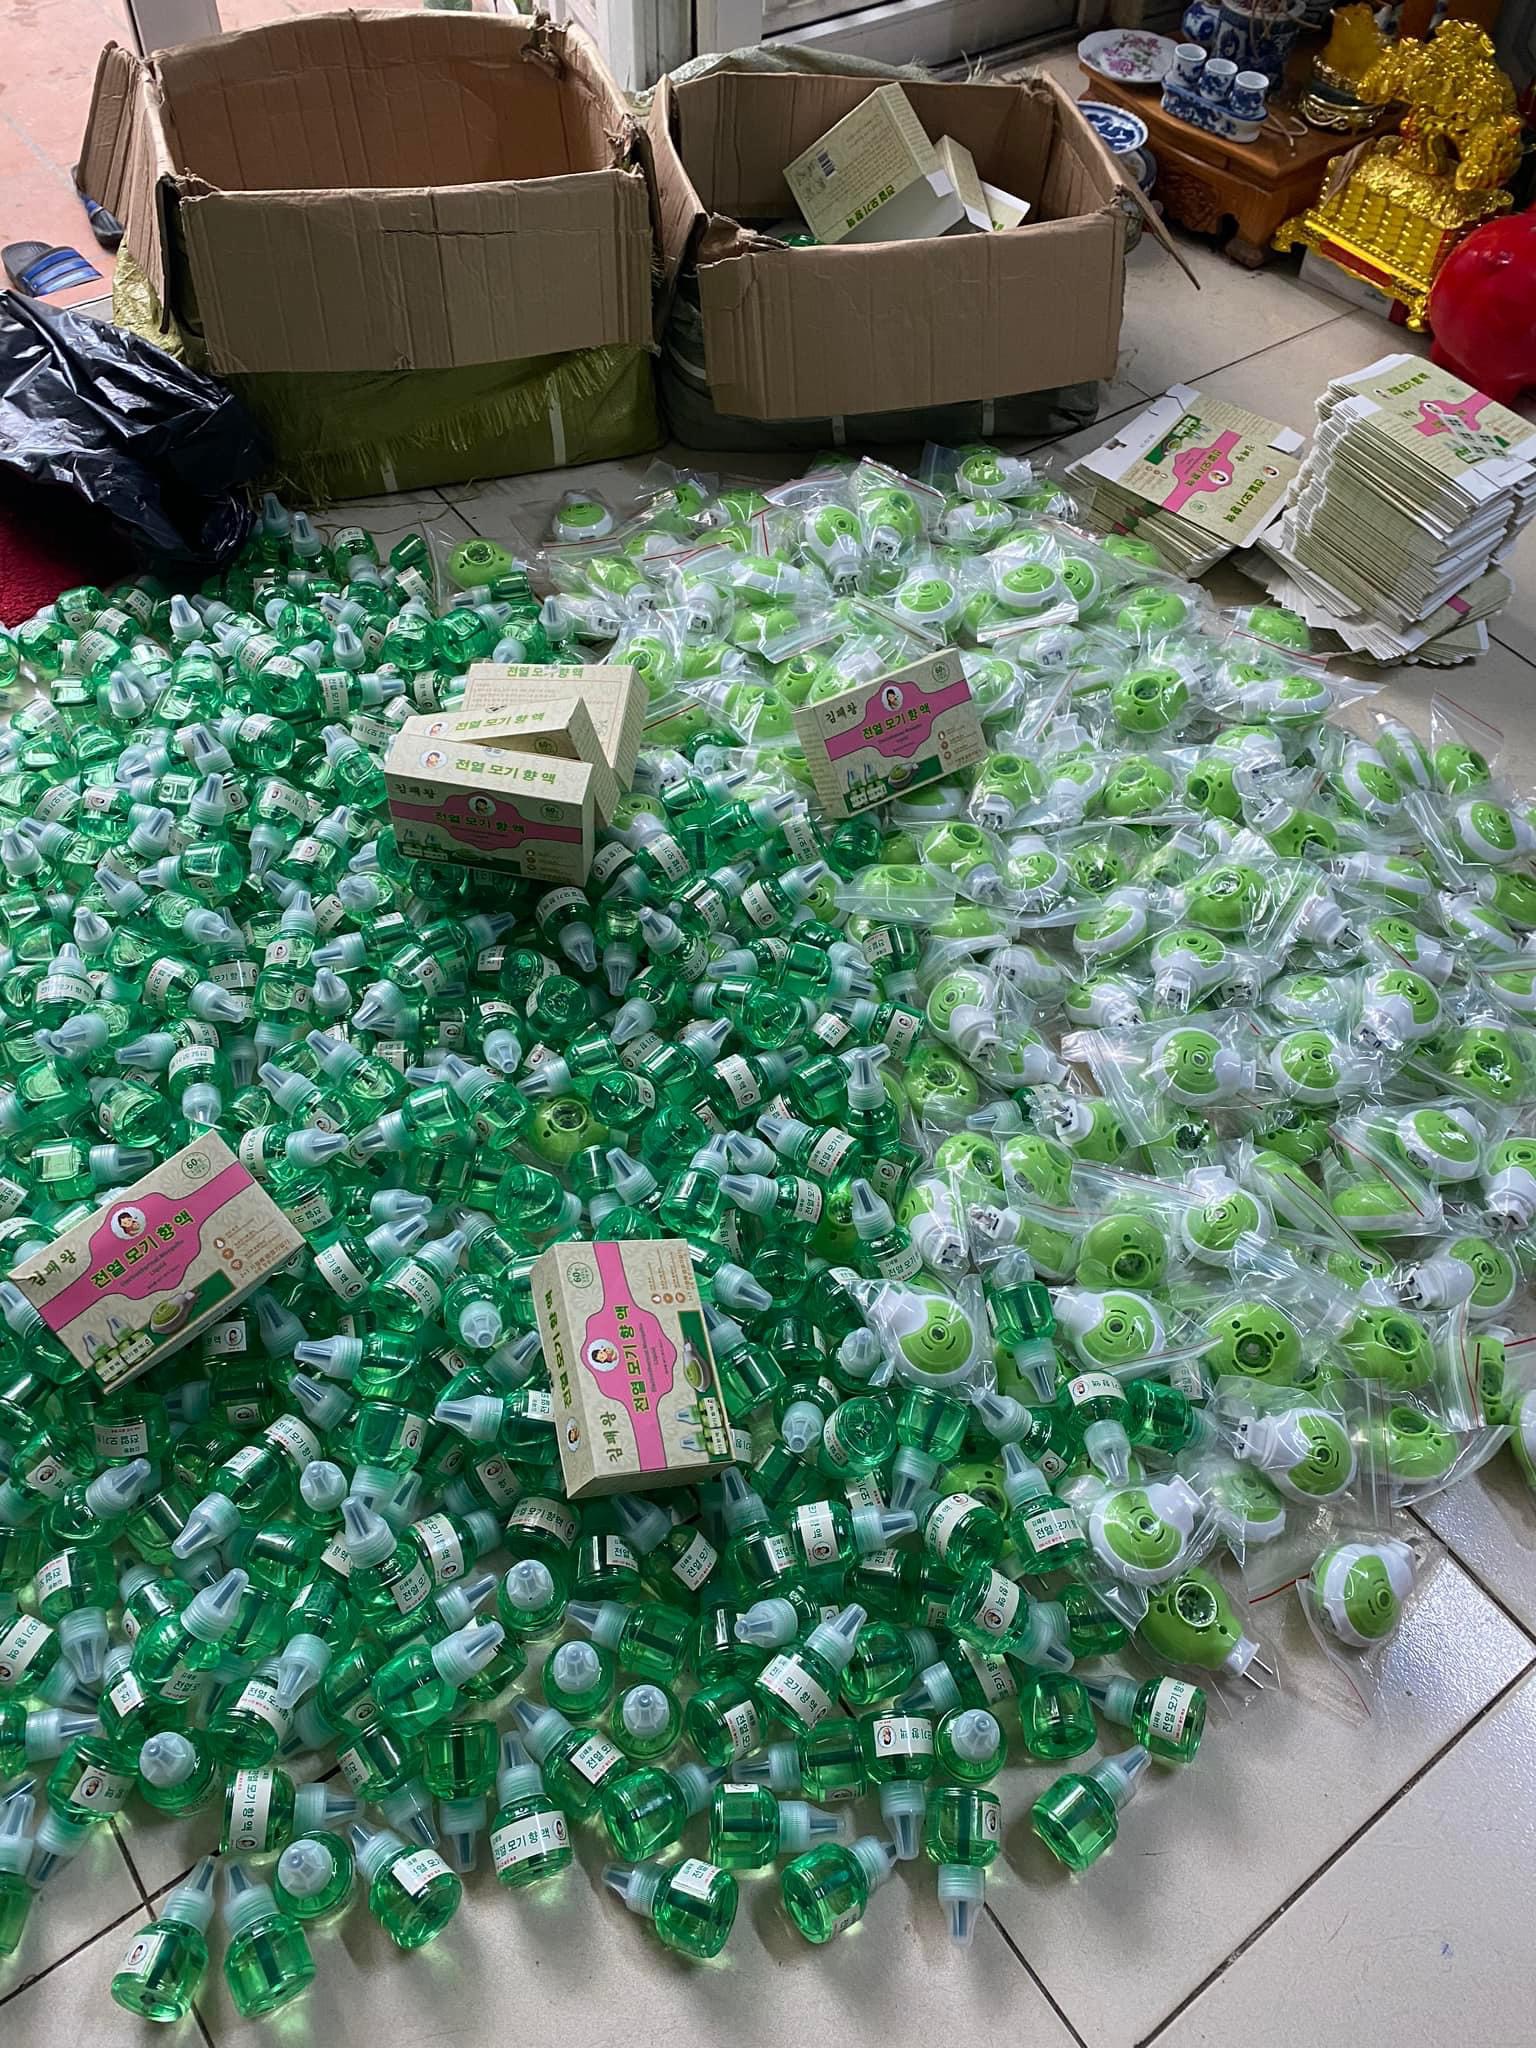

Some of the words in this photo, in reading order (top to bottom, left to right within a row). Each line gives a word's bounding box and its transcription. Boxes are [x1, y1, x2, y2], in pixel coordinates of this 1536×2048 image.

[482, 717, 511, 727] 모기
[862, 722, 884, 740] 전열
[885, 715, 907, 730] 모기
[455, 759, 486, 772] 전열
[487, 763, 519, 778] 모기
[186, 1158, 198, 1170] 60
[90, 1260, 127, 1289] 전열
[124, 1236, 158, 1263] 모기
[572, 1271, 582, 1283] 60
[622, 1344, 641, 1376] 모기
[630, 1380, 649, 1413] 전열
[784, 1676, 803, 1695] 모기
[1168, 1692, 1181, 1712] 모기
[1162, 1712, 1175, 1732] 전열
[586, 1751, 603, 1769] 전열
[507, 1838, 526, 1851] 모기
